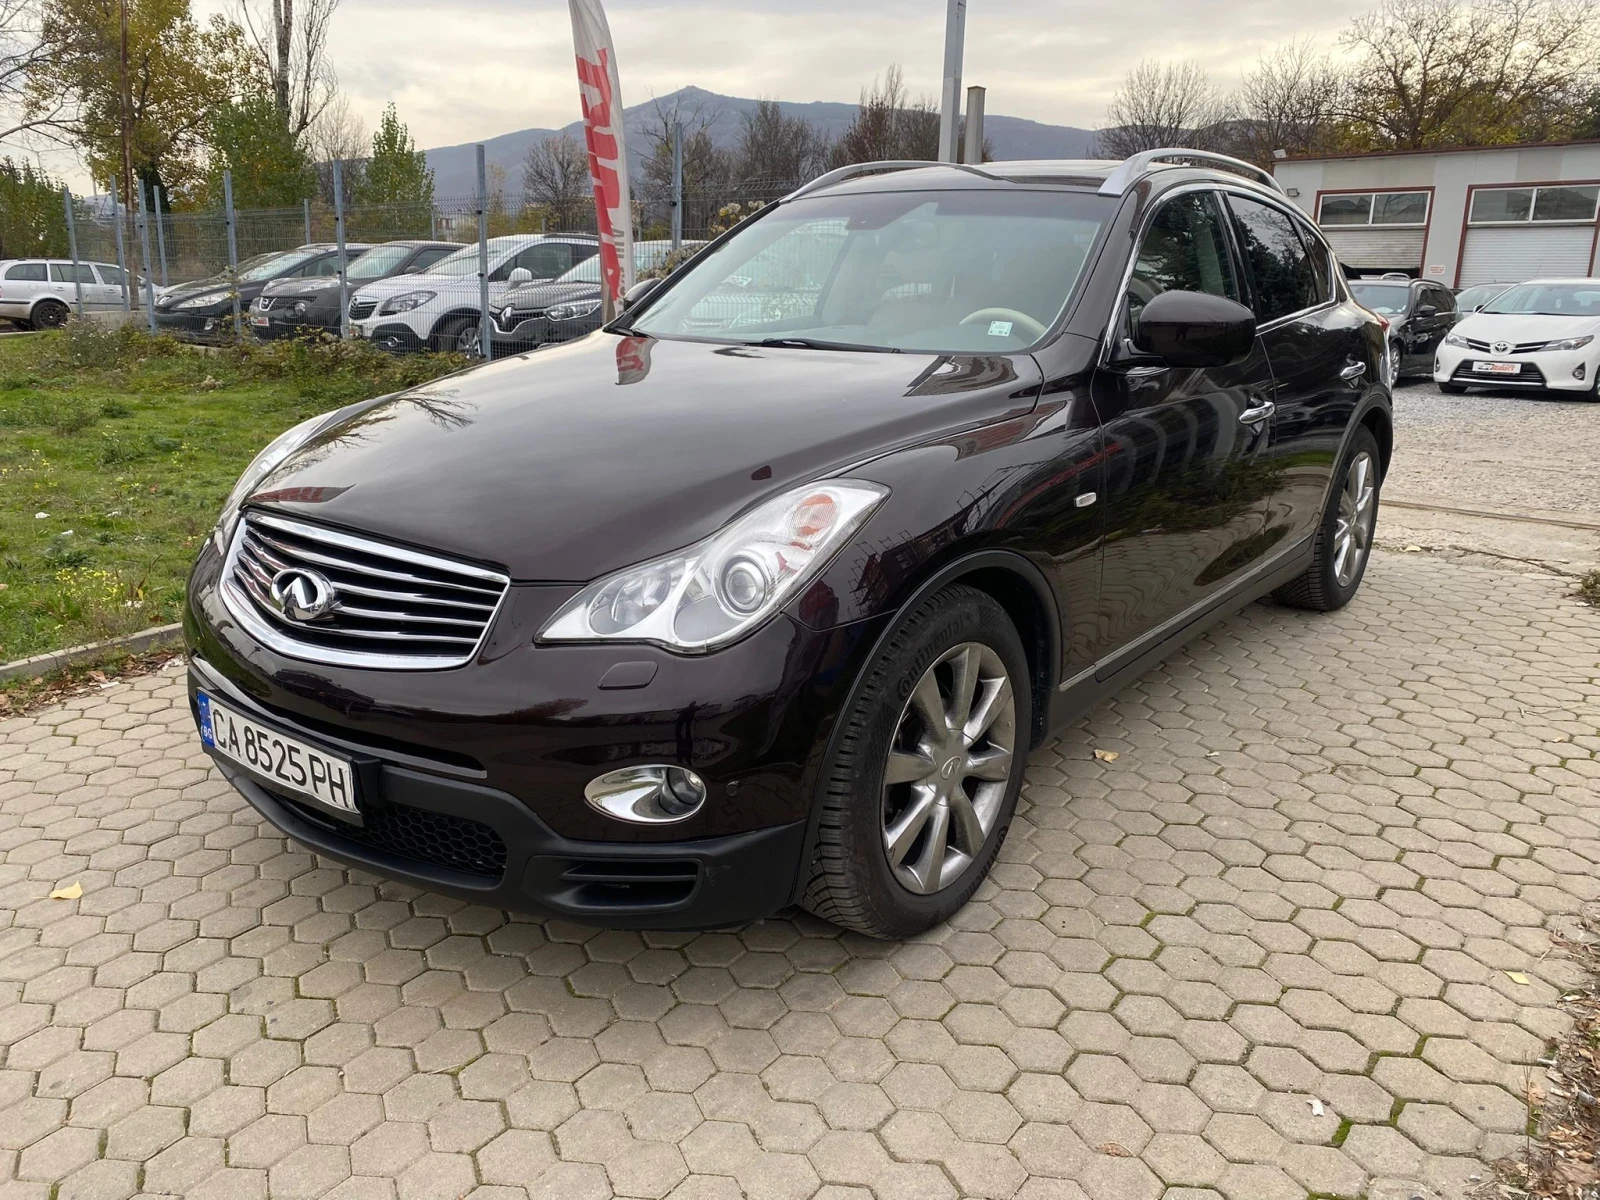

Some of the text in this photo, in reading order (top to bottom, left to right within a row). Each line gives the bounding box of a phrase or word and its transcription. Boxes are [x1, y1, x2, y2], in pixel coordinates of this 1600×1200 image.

[203, 725, 213, 740] BG
[212, 708, 350, 809] CA 8525 PH
